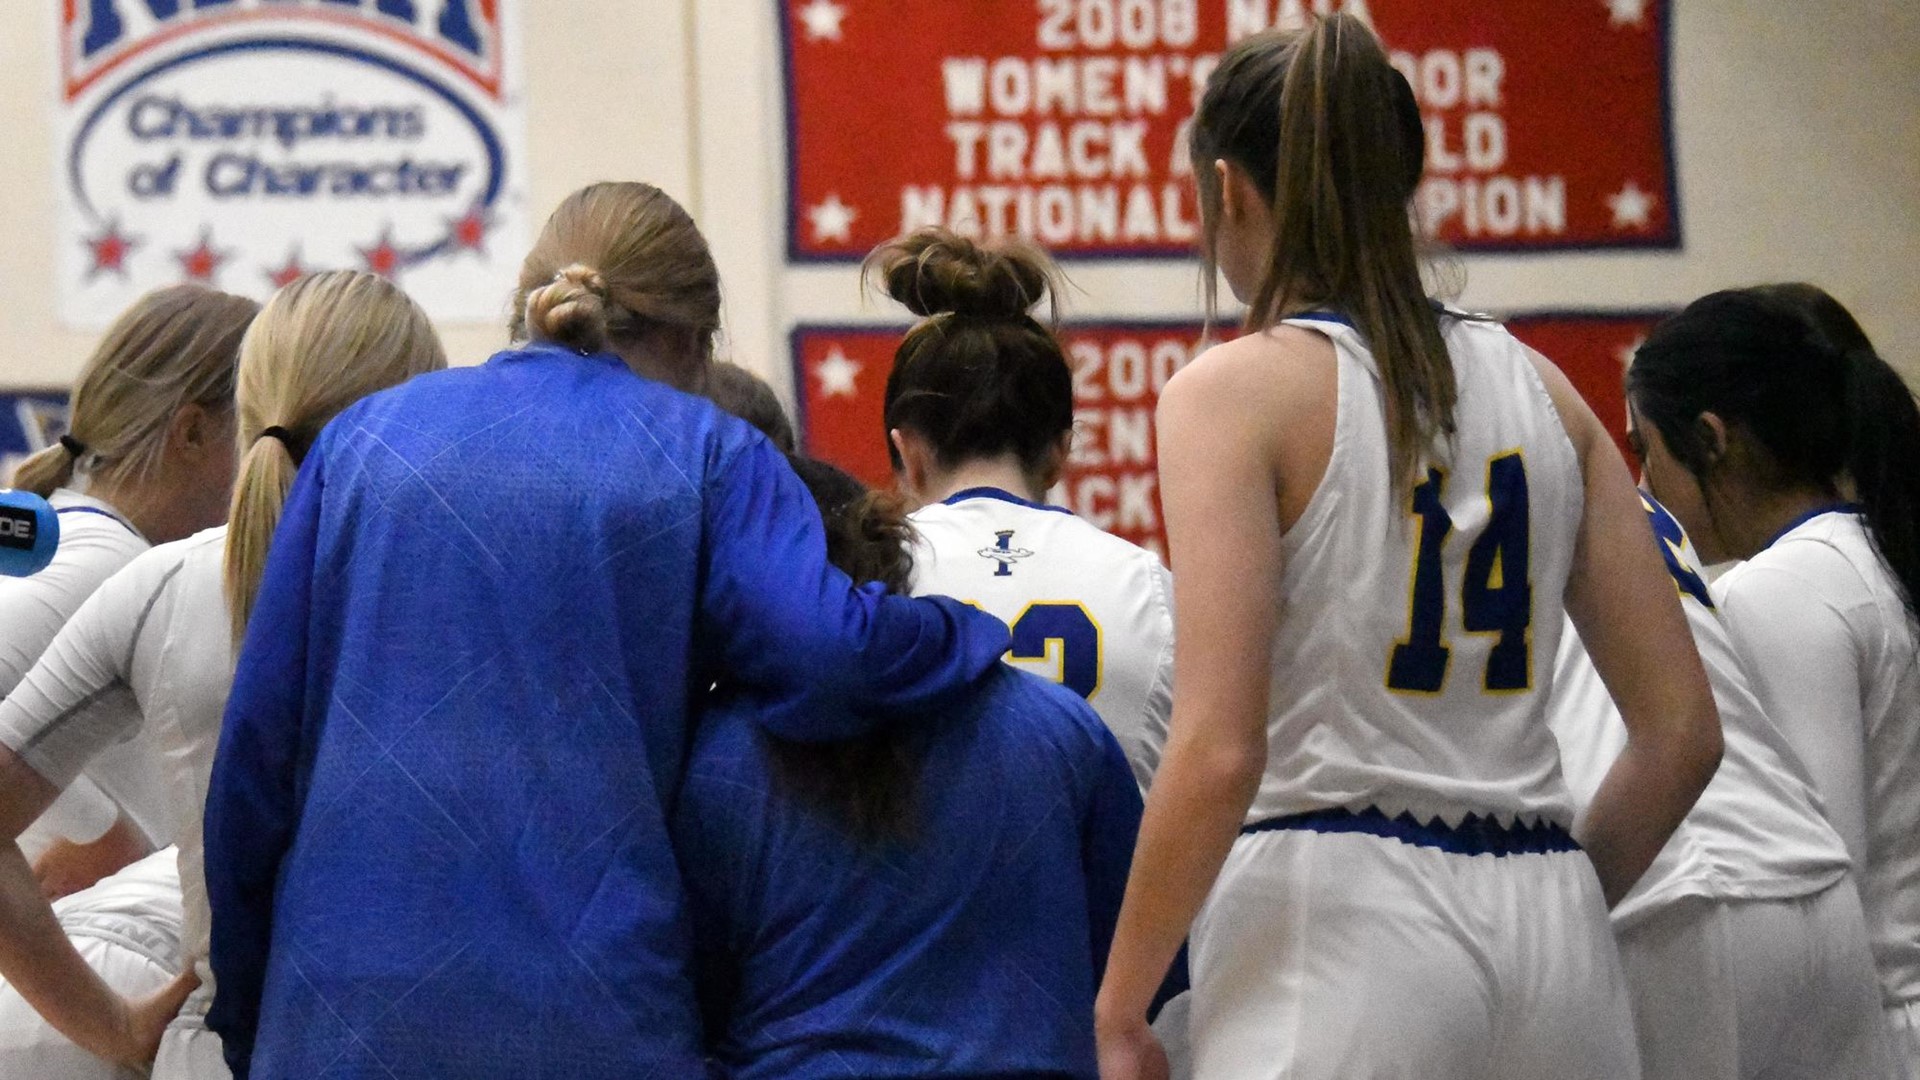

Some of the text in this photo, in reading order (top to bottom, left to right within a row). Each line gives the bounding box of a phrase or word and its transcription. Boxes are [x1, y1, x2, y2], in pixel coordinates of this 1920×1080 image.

[1037, 0, 1198, 50] 2008
[127, 94, 425, 149] Champions
[944, 119, 1150, 179] TRACK
[1426, 112, 1507, 173] LD
[127, 153, 468, 198] of Character
[902, 173, 1567, 243] NATIONAL PION
[1070, 338, 1215, 400] 200
[1069, 407, 1149, 466] EN
[1384, 447, 1534, 696] 14
